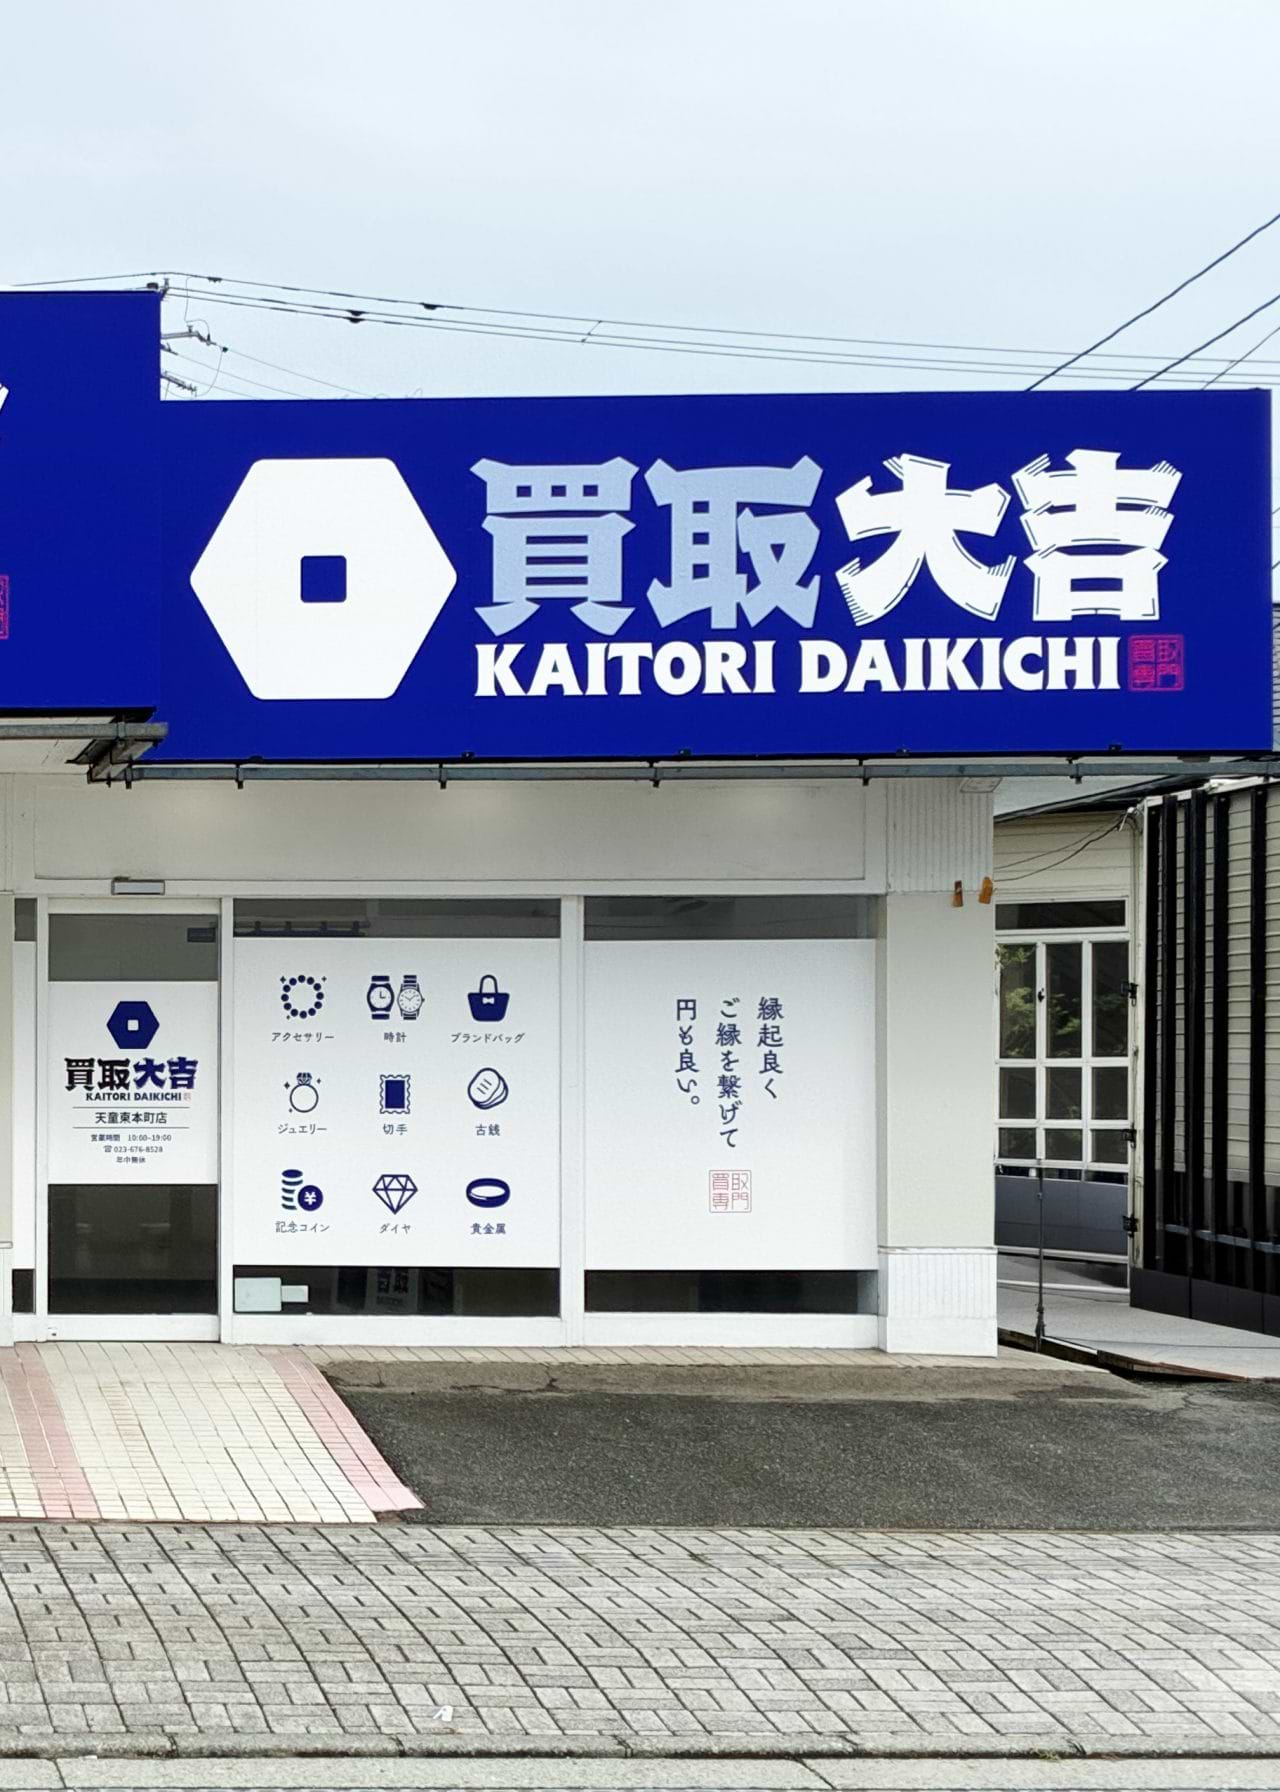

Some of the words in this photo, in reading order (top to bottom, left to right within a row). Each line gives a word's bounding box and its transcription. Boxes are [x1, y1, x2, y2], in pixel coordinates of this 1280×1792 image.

[470, 449, 1182, 635] 買取大吉
[475, 641, 776, 696] KAITORI
[799, 637, 1120, 692] DAIKICHI
[272, 1032, 334, 1042] アクセサリー
[384, 1032, 407, 1043] 時計
[451, 1032, 525, 1043] ブランドバッグ
[675, 999, 700, 1104] 円も良い。
[757, 996, 784, 1099] 縁起良く
[64, 1056, 198, 1091] 買取大吉
[715, 997, 742, 1147] ご縁を繋げて
[86, 1092, 130, 1101] KAITORI
[134, 1092, 181, 1101] DAIKICHI
[95, 1112, 167, 1124] 天童東本町店
[278, 1123, 327, 1135] ジュエリー
[383, 1124, 407, 1135] 切手
[475, 1124, 500, 1136] 古銭
[275, 1221, 330, 1233] 記念コイン
[380, 1223, 411, 1234] ダイヤ
[471, 1223, 506, 1235] 貴金属
